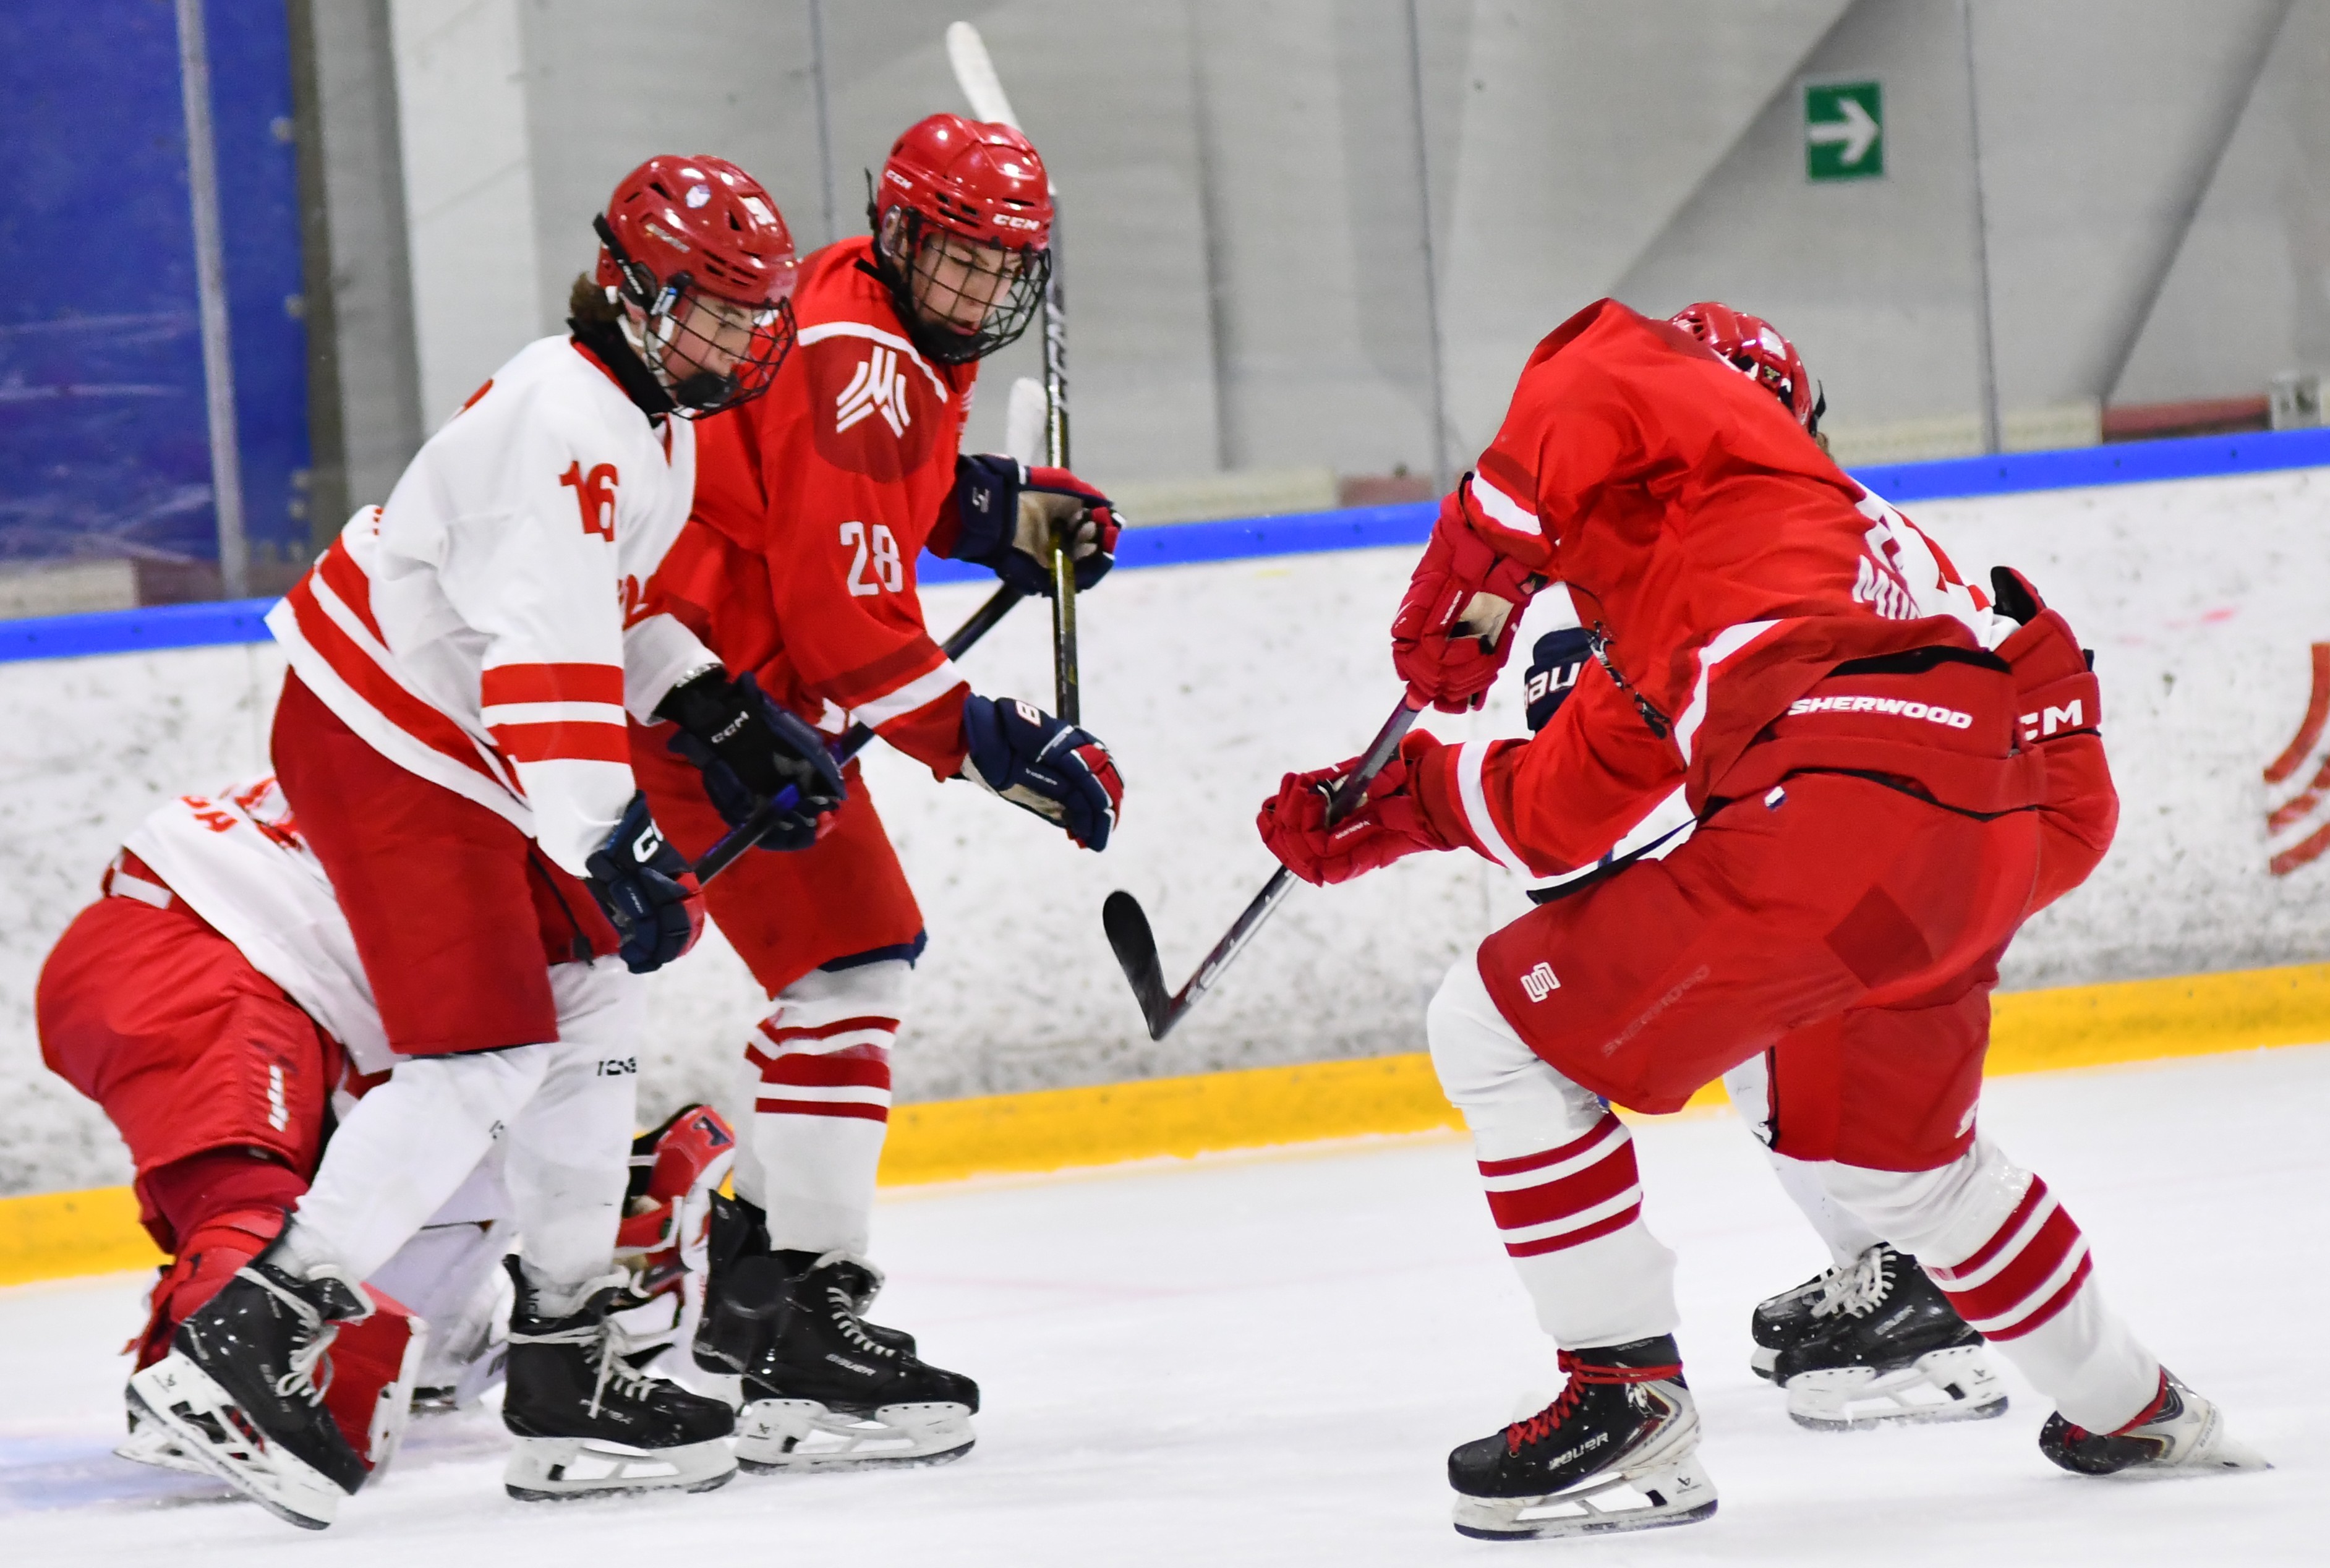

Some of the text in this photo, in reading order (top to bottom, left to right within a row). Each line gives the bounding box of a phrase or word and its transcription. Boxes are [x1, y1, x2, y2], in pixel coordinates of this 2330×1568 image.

[992, 213, 1041, 231] CCM
[558, 460, 620, 543] 16
[839, 521, 903, 597] 28
[711, 710, 750, 744] CCM
[1787, 696, 1973, 730] SHERWOOD
